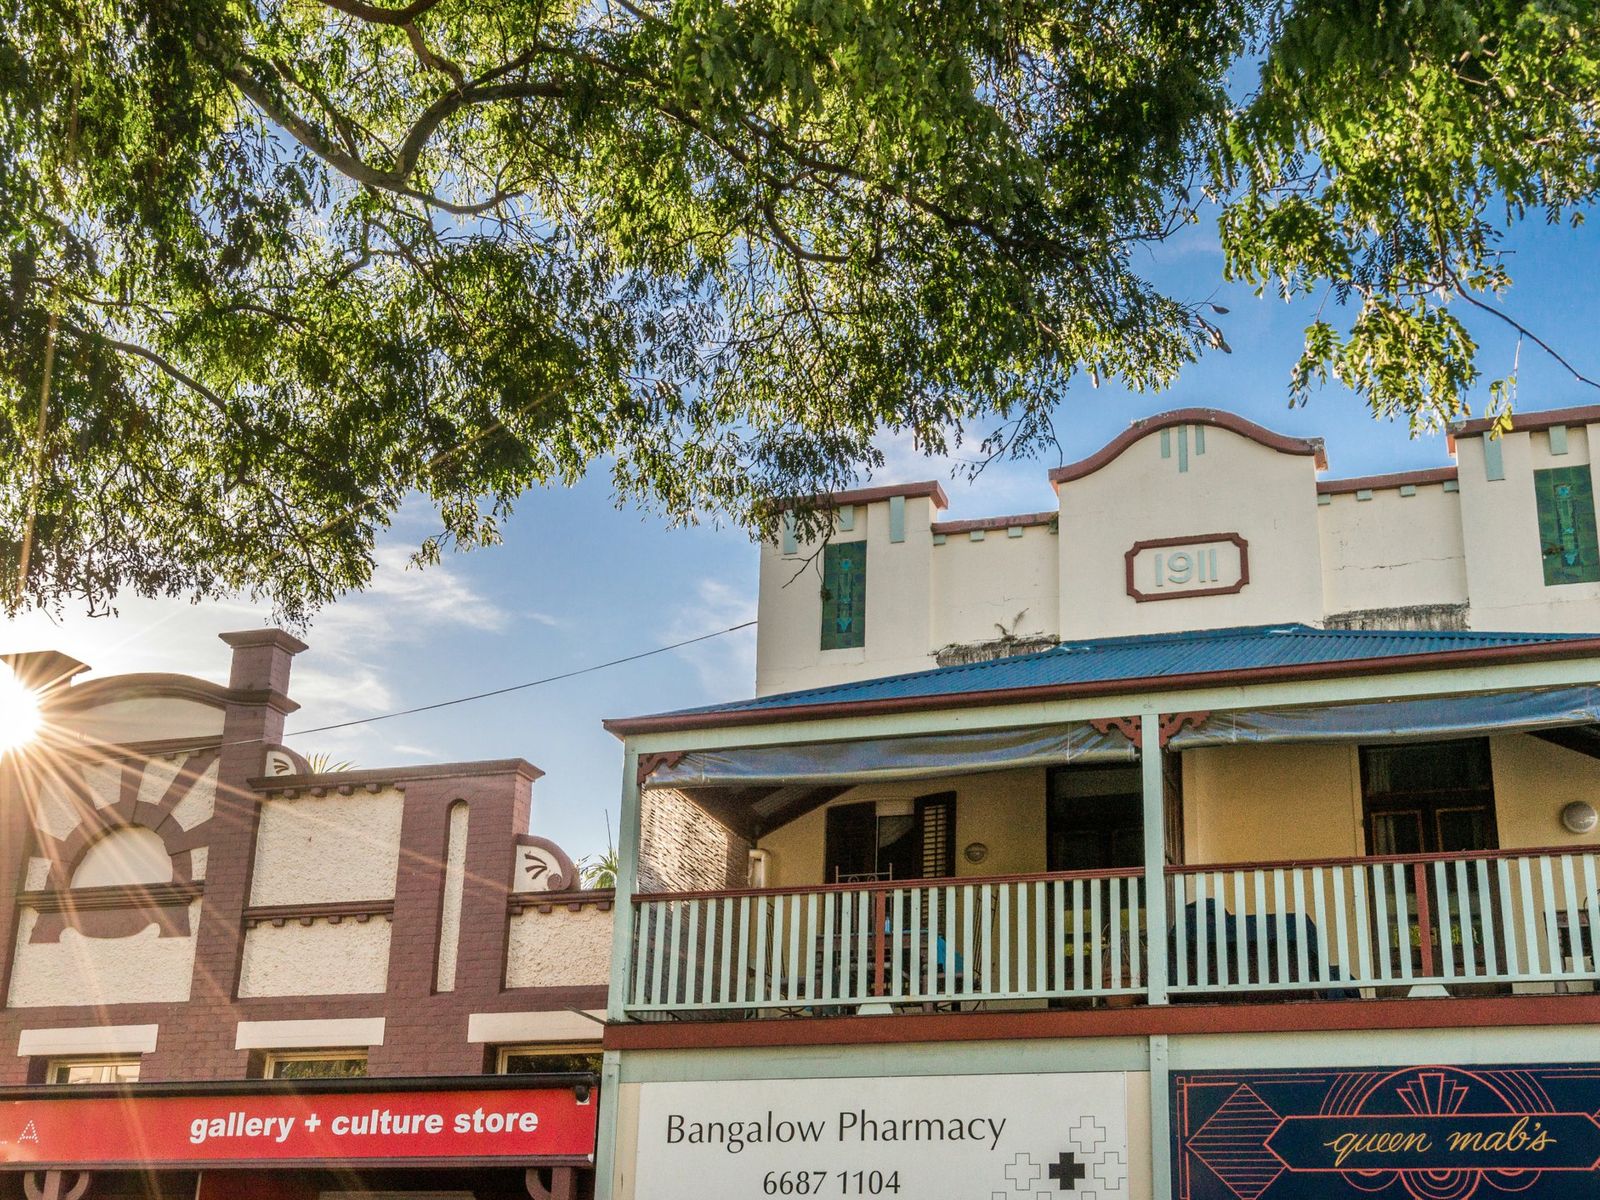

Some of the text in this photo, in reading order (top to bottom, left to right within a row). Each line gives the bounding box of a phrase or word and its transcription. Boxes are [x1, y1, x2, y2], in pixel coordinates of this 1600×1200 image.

[1155, 549, 1218, 587] 1911
[190, 1106, 538, 1144] gallery + culture store
[666, 1109, 1006, 1153] Bangalow Pharmacy
[1323, 1115, 1557, 1168] queen mab's
[762, 1169, 901, 1196] 6687 1104
